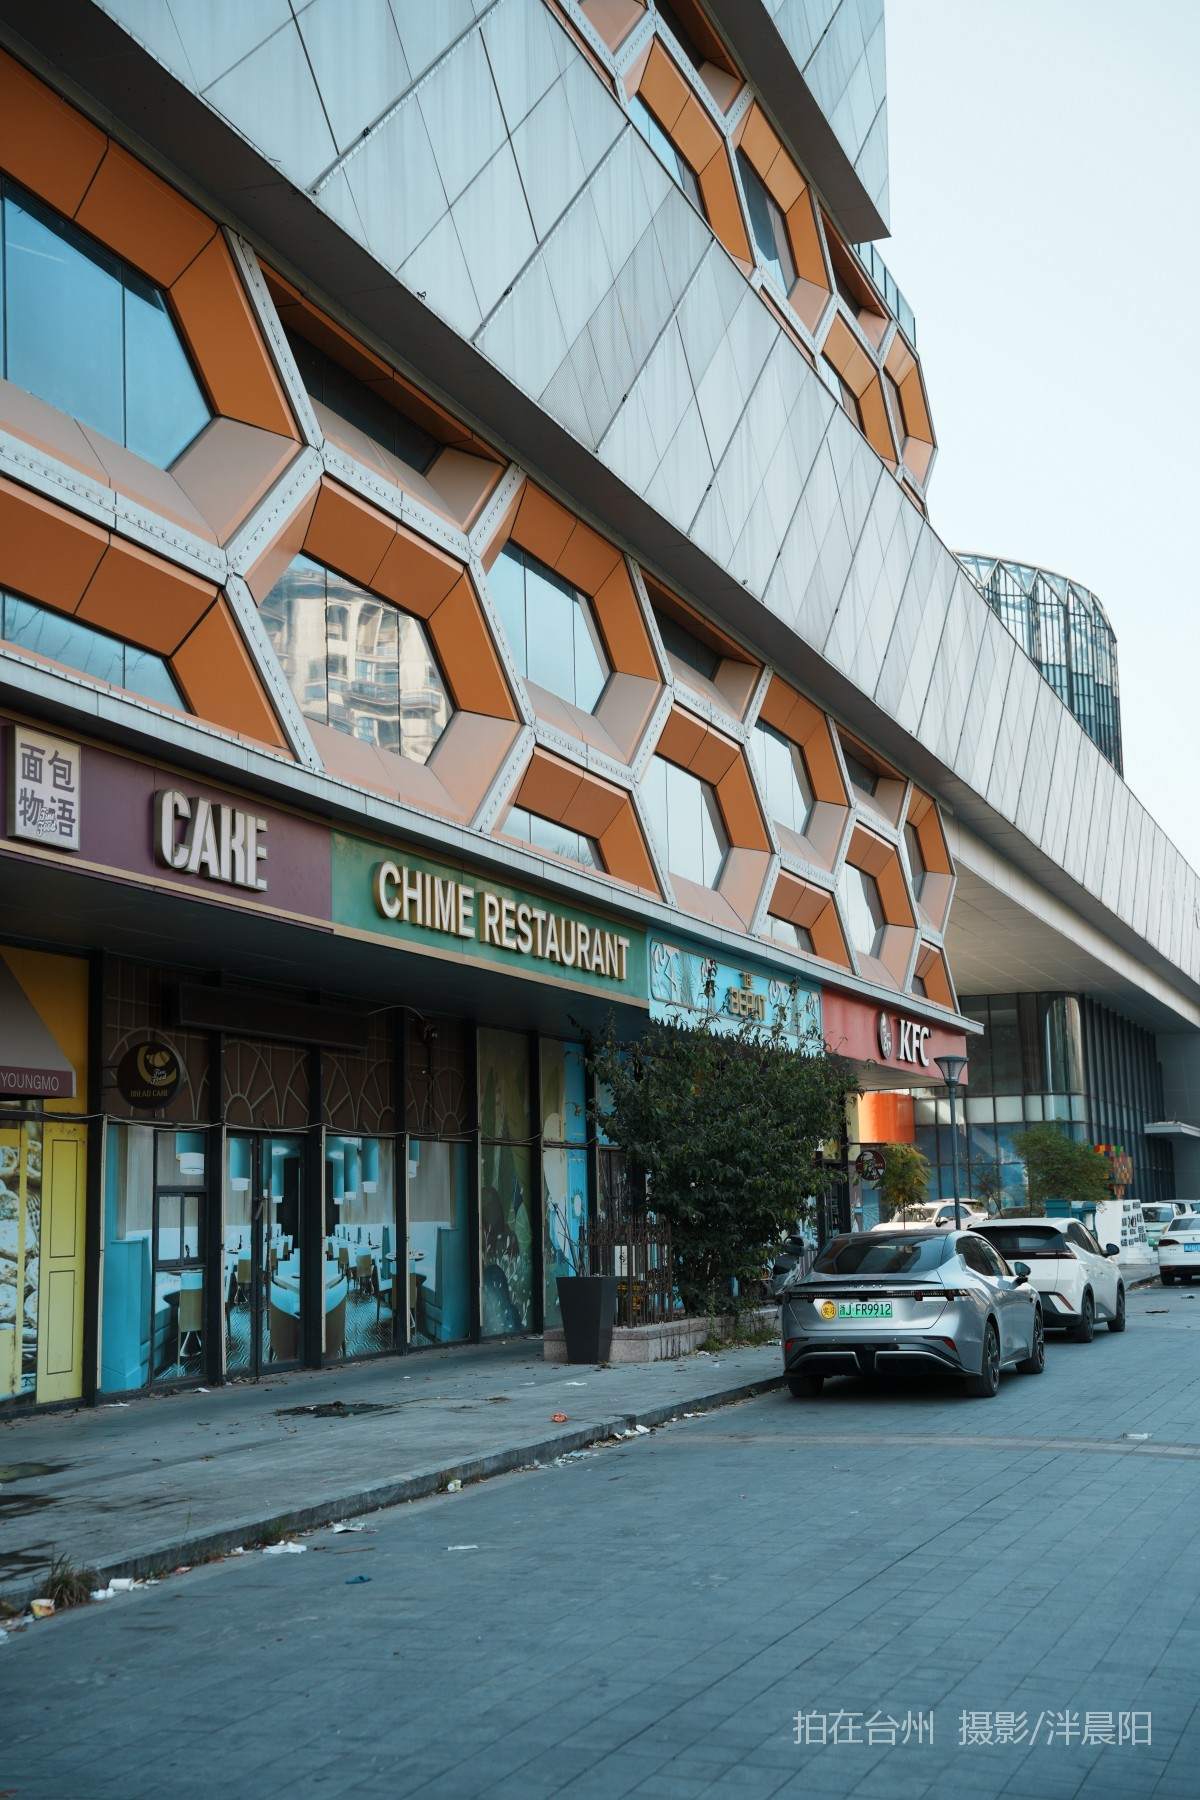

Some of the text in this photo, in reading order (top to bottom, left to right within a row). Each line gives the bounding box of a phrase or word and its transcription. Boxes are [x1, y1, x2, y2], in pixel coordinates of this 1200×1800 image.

[20, 741, 75, 793] 面包
[18, 787, 76, 837] 物语
[157, 789, 268, 892] CAKE
[374, 860, 630, 981] CHIME RESTAURANT
[898, 1018, 931, 1067] KFC
[0, 1071, 60, 1091] YOUNGMO
